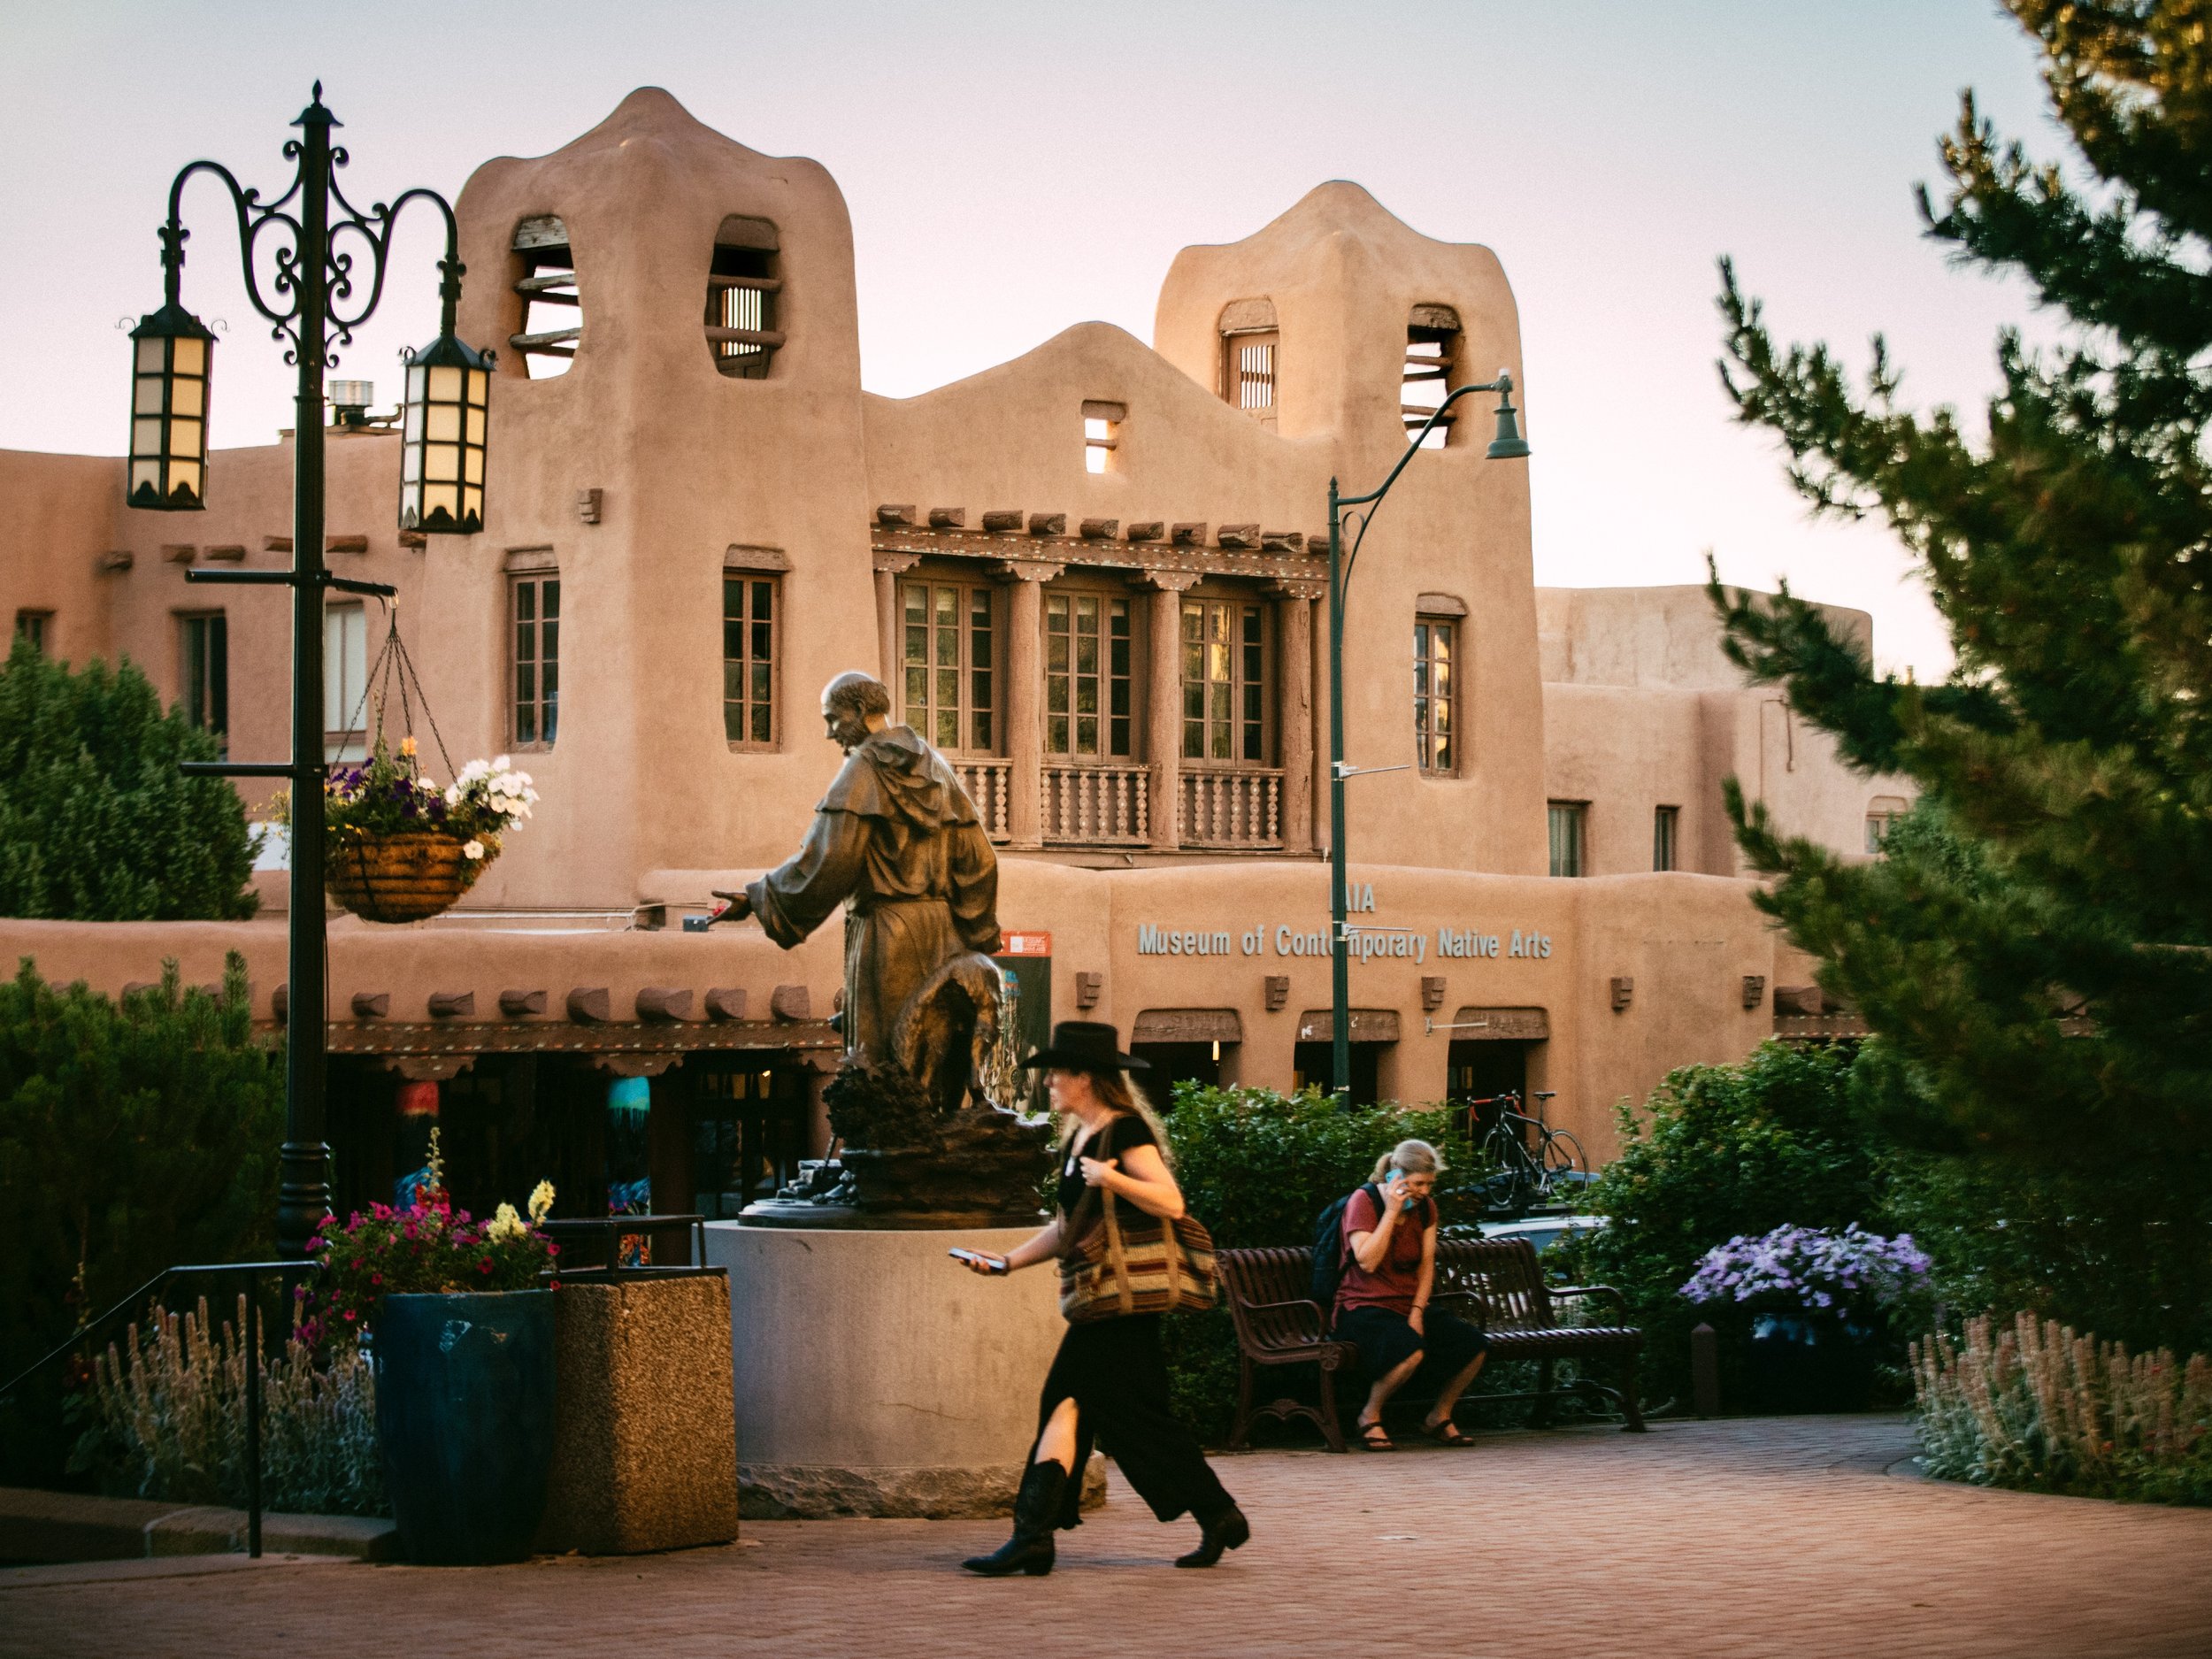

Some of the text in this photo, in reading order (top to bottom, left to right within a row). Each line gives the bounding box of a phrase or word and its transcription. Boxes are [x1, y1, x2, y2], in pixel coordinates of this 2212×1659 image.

[1138, 925, 1231, 956] Museum
[1243, 925, 1264, 956] of
[1439, 929, 1502, 958] Native
[1509, 930, 1553, 958] Arts
